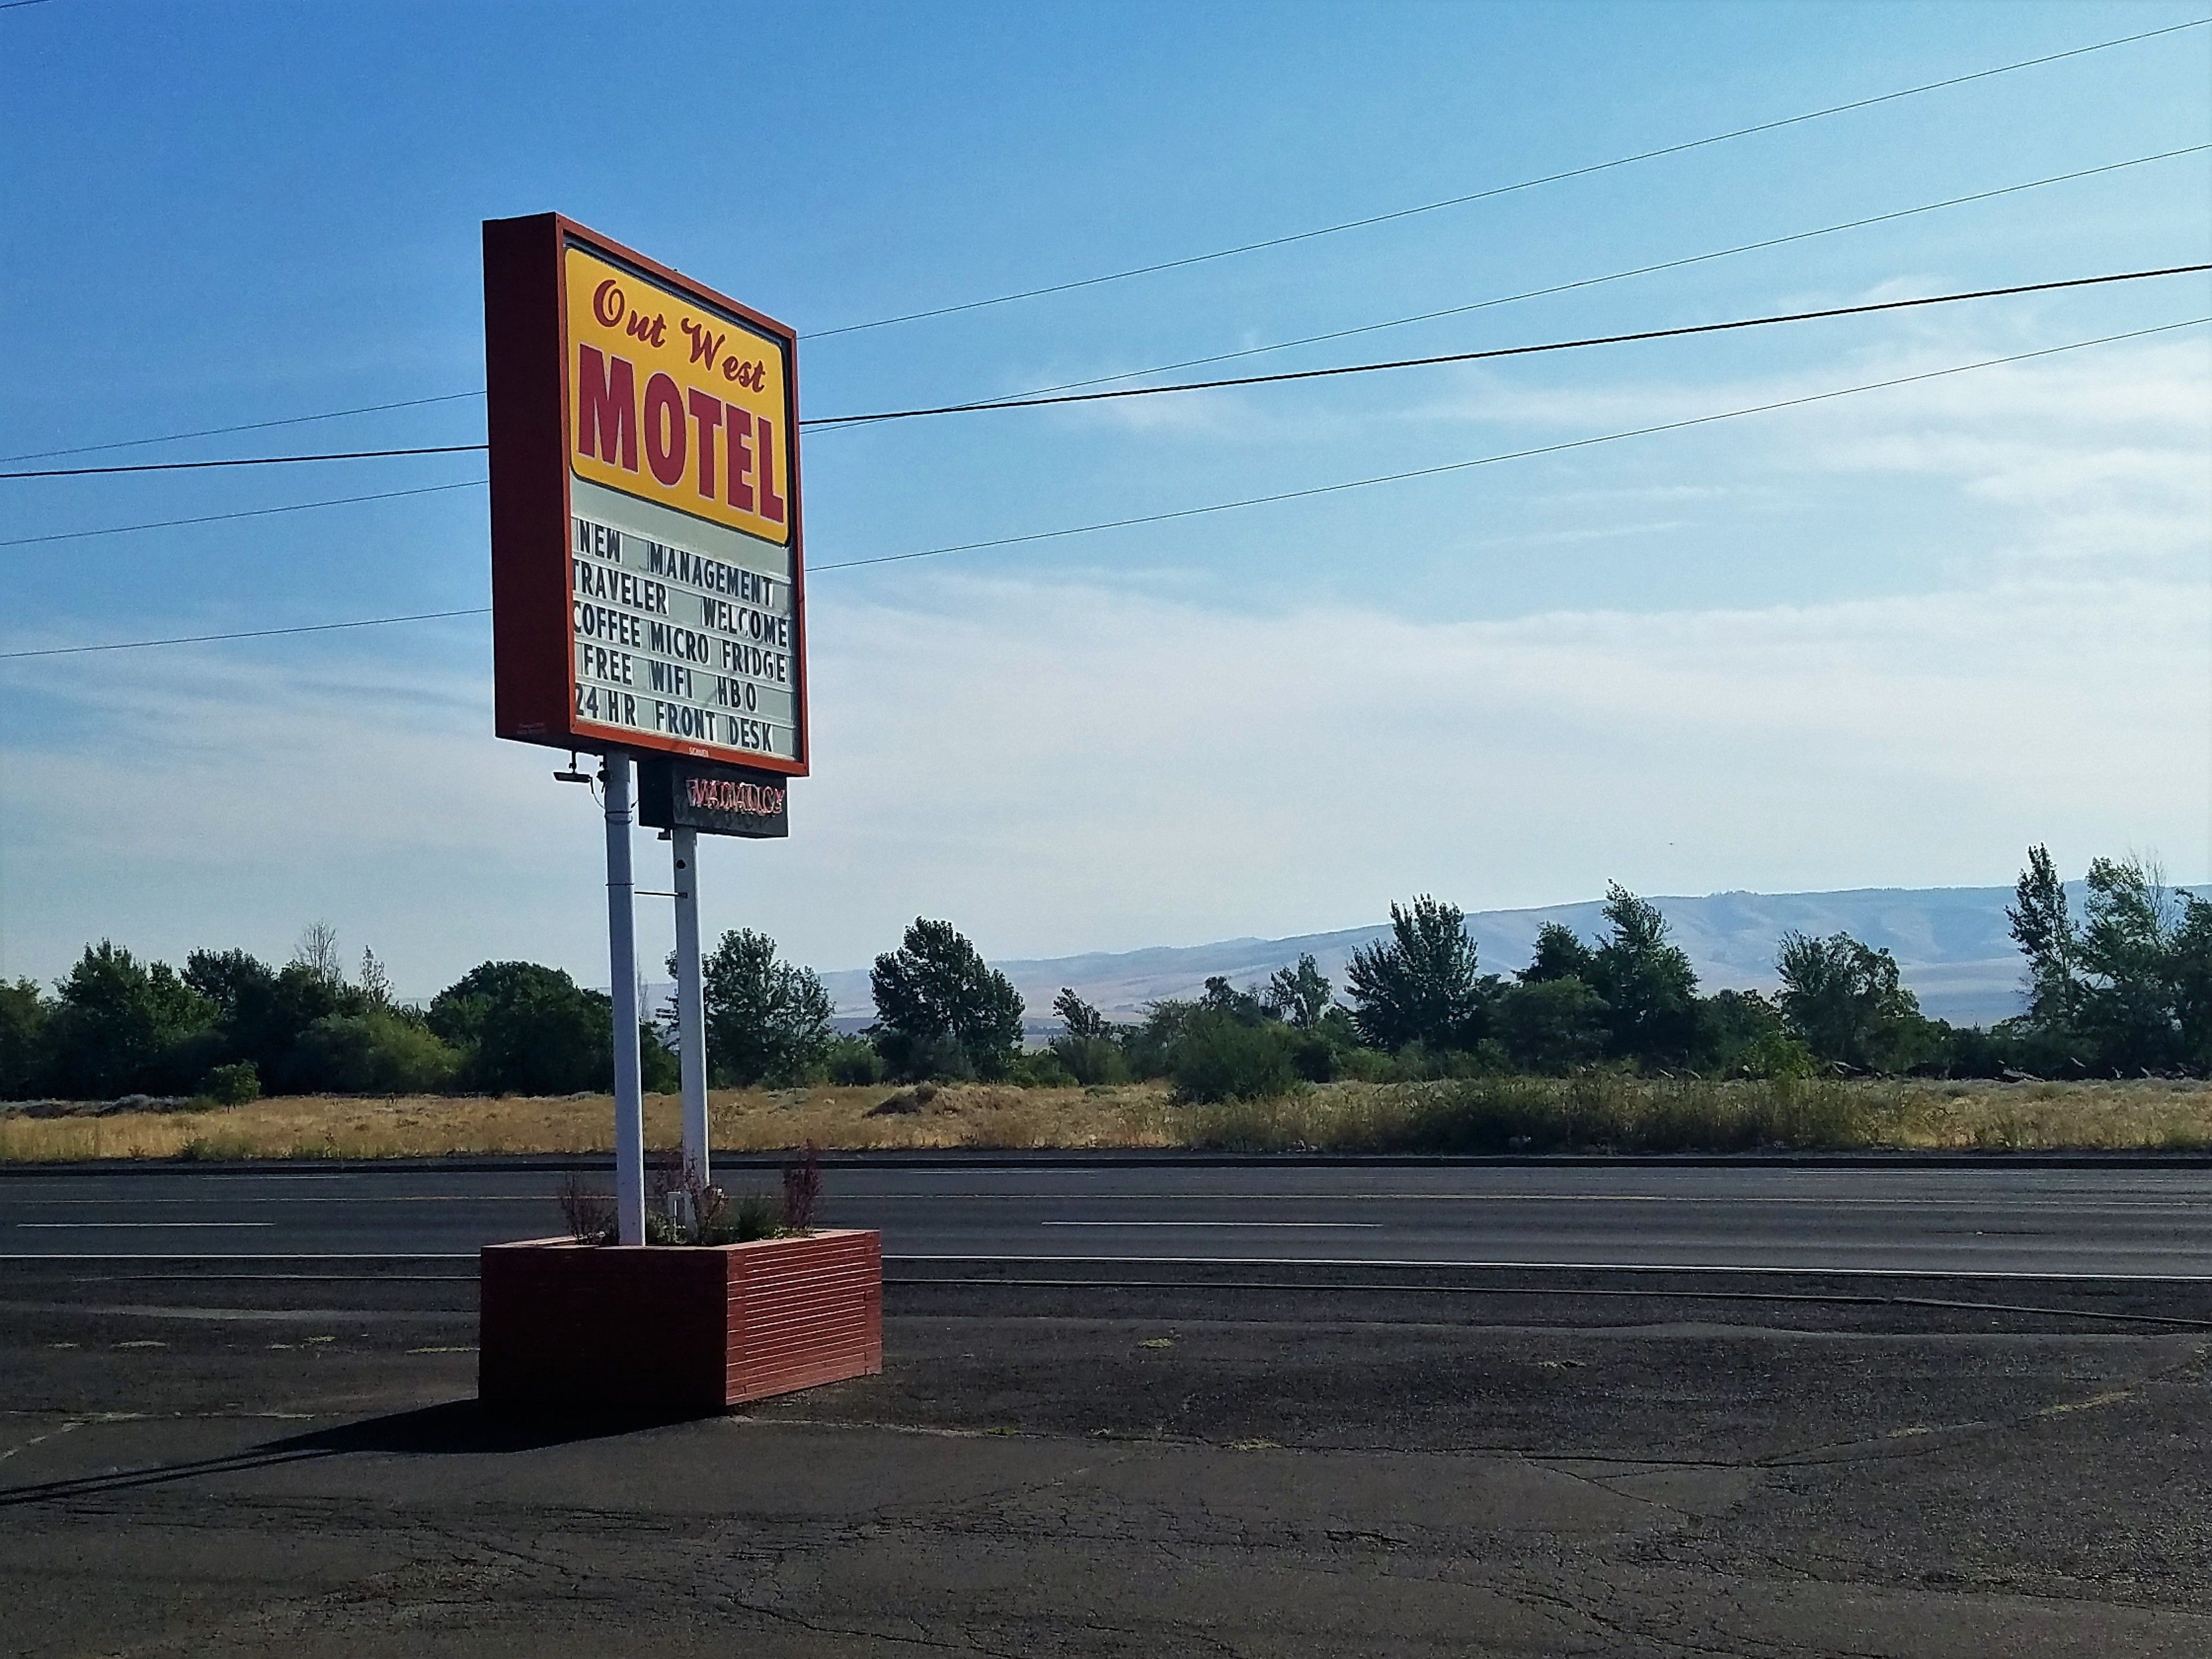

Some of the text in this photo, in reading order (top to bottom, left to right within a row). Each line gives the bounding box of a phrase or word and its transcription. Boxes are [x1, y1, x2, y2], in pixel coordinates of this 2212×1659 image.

[593, 279, 766, 393] Out West
[578, 343, 784, 524] MOTEL
[579, 520, 773, 606] NEW MANAGEMENT
[574, 601, 786, 683] COFFEE MICRO FRIDGE
[702, 597, 787, 647] WELCOME
[575, 683, 773, 752] 24 HR FRONT DESK
[584, 643, 757, 712] FREE WIFI HBO
